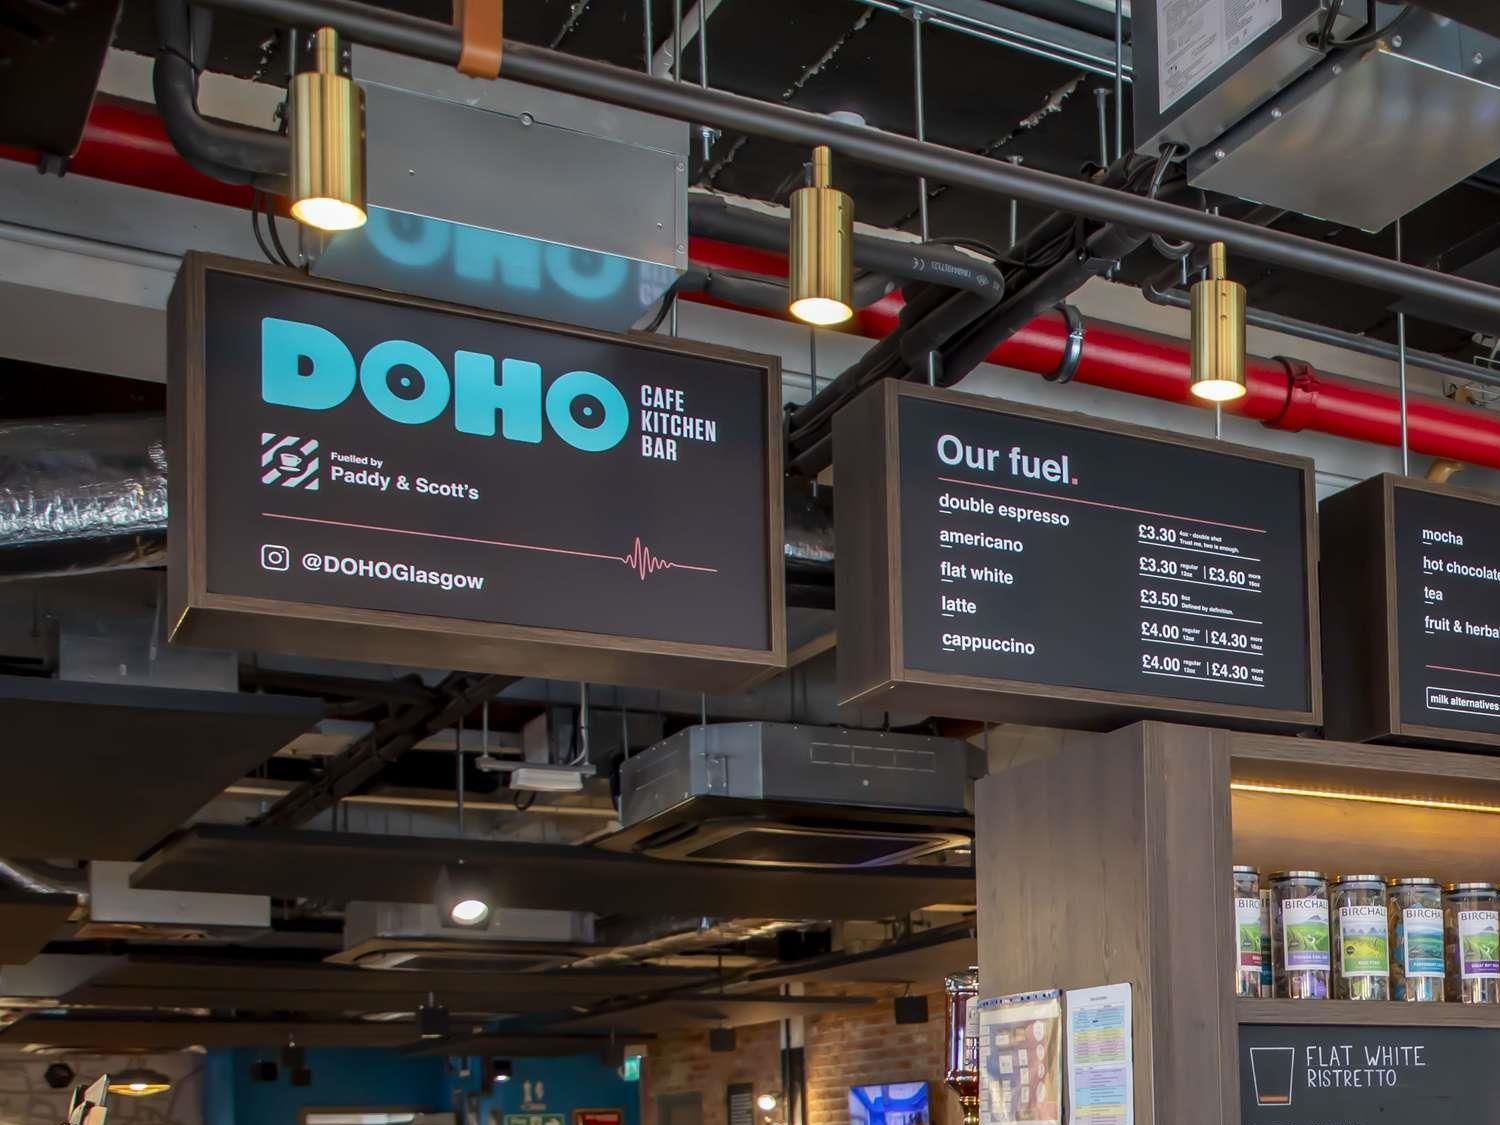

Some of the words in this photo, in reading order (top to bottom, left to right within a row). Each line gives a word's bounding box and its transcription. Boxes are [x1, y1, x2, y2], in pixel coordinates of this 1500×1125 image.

[261, 317, 629, 452] DOHO
[640, 384, 684, 412] CAFE
[640, 410, 717, 442] KITCHEN
[331, 451, 367, 467] Fuelled
[369, 457, 383, 470] by
[640, 435, 677, 461] BAR
[937, 433, 999, 473] Our
[1009, 446, 1079, 486] fuel.
[331, 466, 390, 492] Paddy
[396, 475, 410, 491] &
[415, 477, 479, 500] Scott's
[939, 493, 994, 515] double
[998, 502, 1070, 527] espresso
[940, 529, 1024, 553] americano
[1138, 524, 1176, 543] £3.30
[1423, 528, 1463, 546] mocha
[302, 552, 484, 590] @DOHOGlasgow
[941, 561, 967, 580] flat
[970, 566, 1014, 586] white
[1139, 557, 1177, 575] £3.30
[1209, 567, 1245, 585] £3.60
[1423, 556, 1443, 573] hot
[941, 595, 977, 615] latte
[1140, 589, 1178, 607] £3.50
[1424, 586, 1443, 601] tea
[1141, 621, 1179, 640] £4.00
[1211, 630, 1247, 648] £4.30
[1424, 615, 1451, 633] fruit
[1453, 620, 1462, 633] &
[942, 632, 1035, 657] cappuccino
[1142, 654, 1180, 672] £4.00
[1212, 662, 1248, 680] £4.30
[1431, 694, 1449, 705] milk
[1306, 1046, 1352, 1067] FLAT
[1364, 1046, 1426, 1067] WHITE
[1308, 1069, 1396, 1088] RISTRETTO
